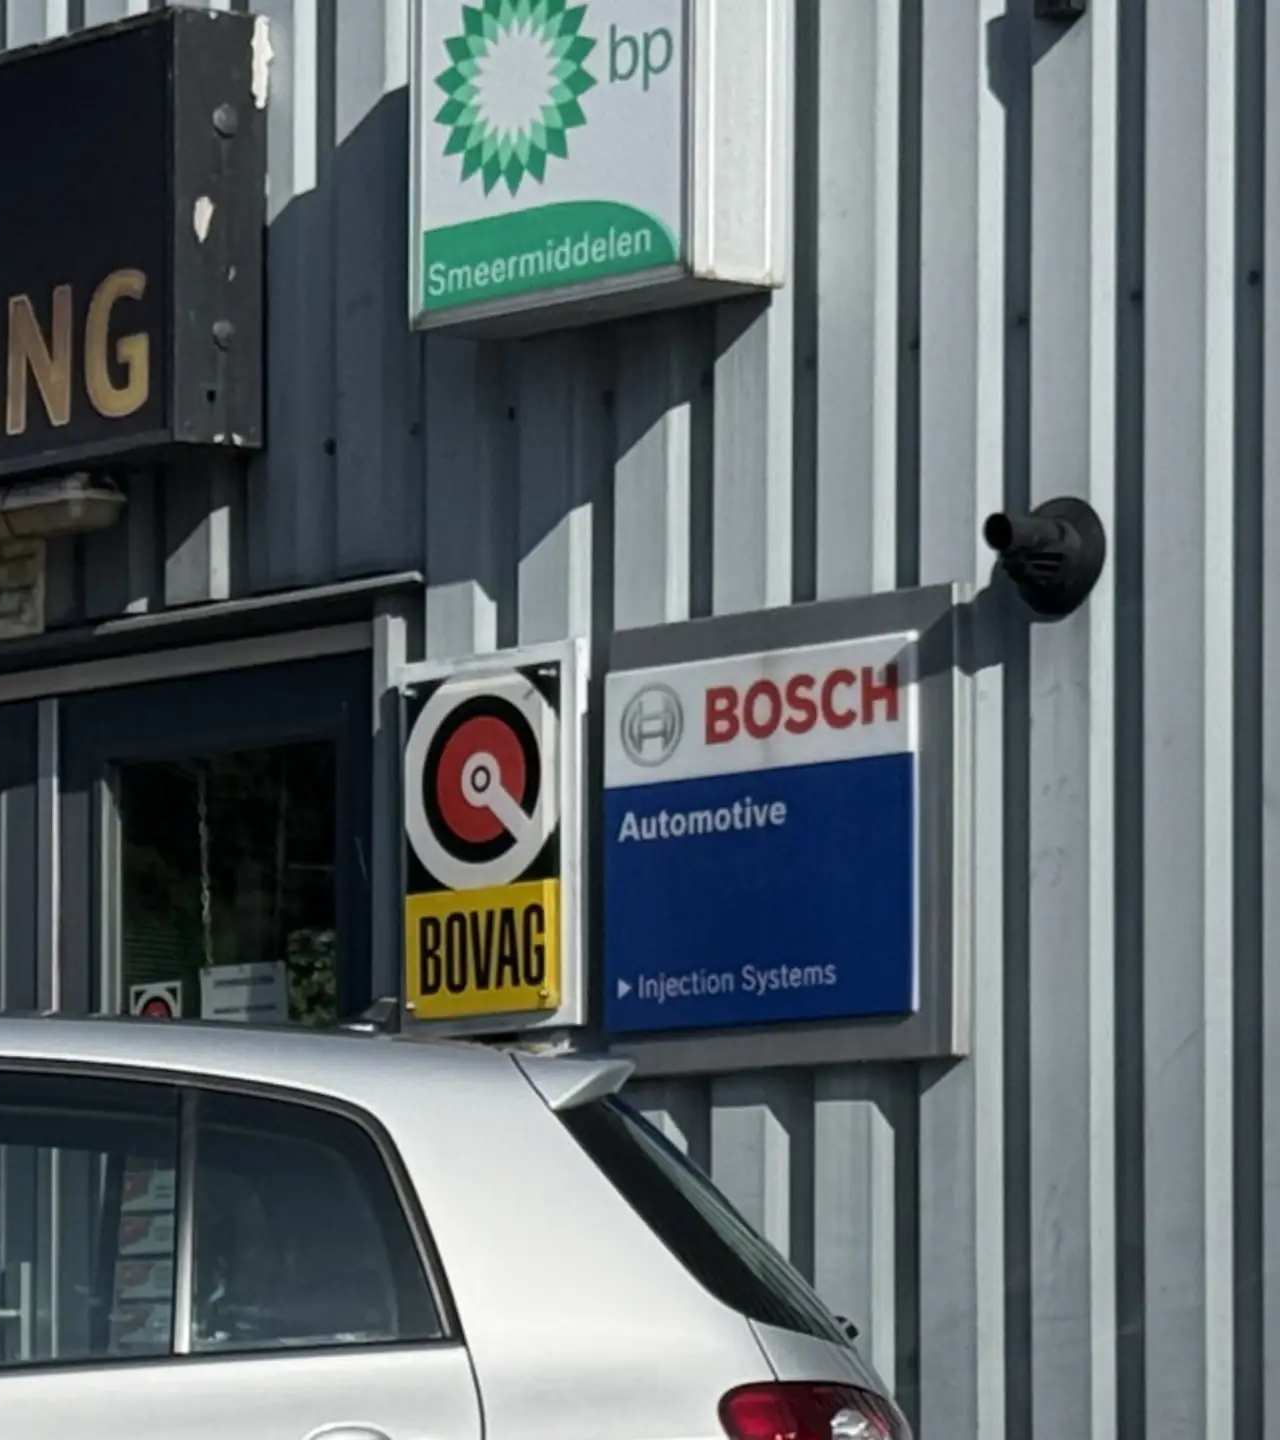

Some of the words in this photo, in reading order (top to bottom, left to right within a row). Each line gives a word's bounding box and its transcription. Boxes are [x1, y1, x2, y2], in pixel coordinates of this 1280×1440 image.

[609, 23, 674, 91] bp
[427, 226, 652, 297] Smeermiddelen
[704, 662, 900, 745] BOSCH
[618, 795, 787, 843] Automotive
[419, 902, 546, 996] BOVAG
[637, 972, 734, 1001] Injection
[741, 962, 837, 994] Systems
